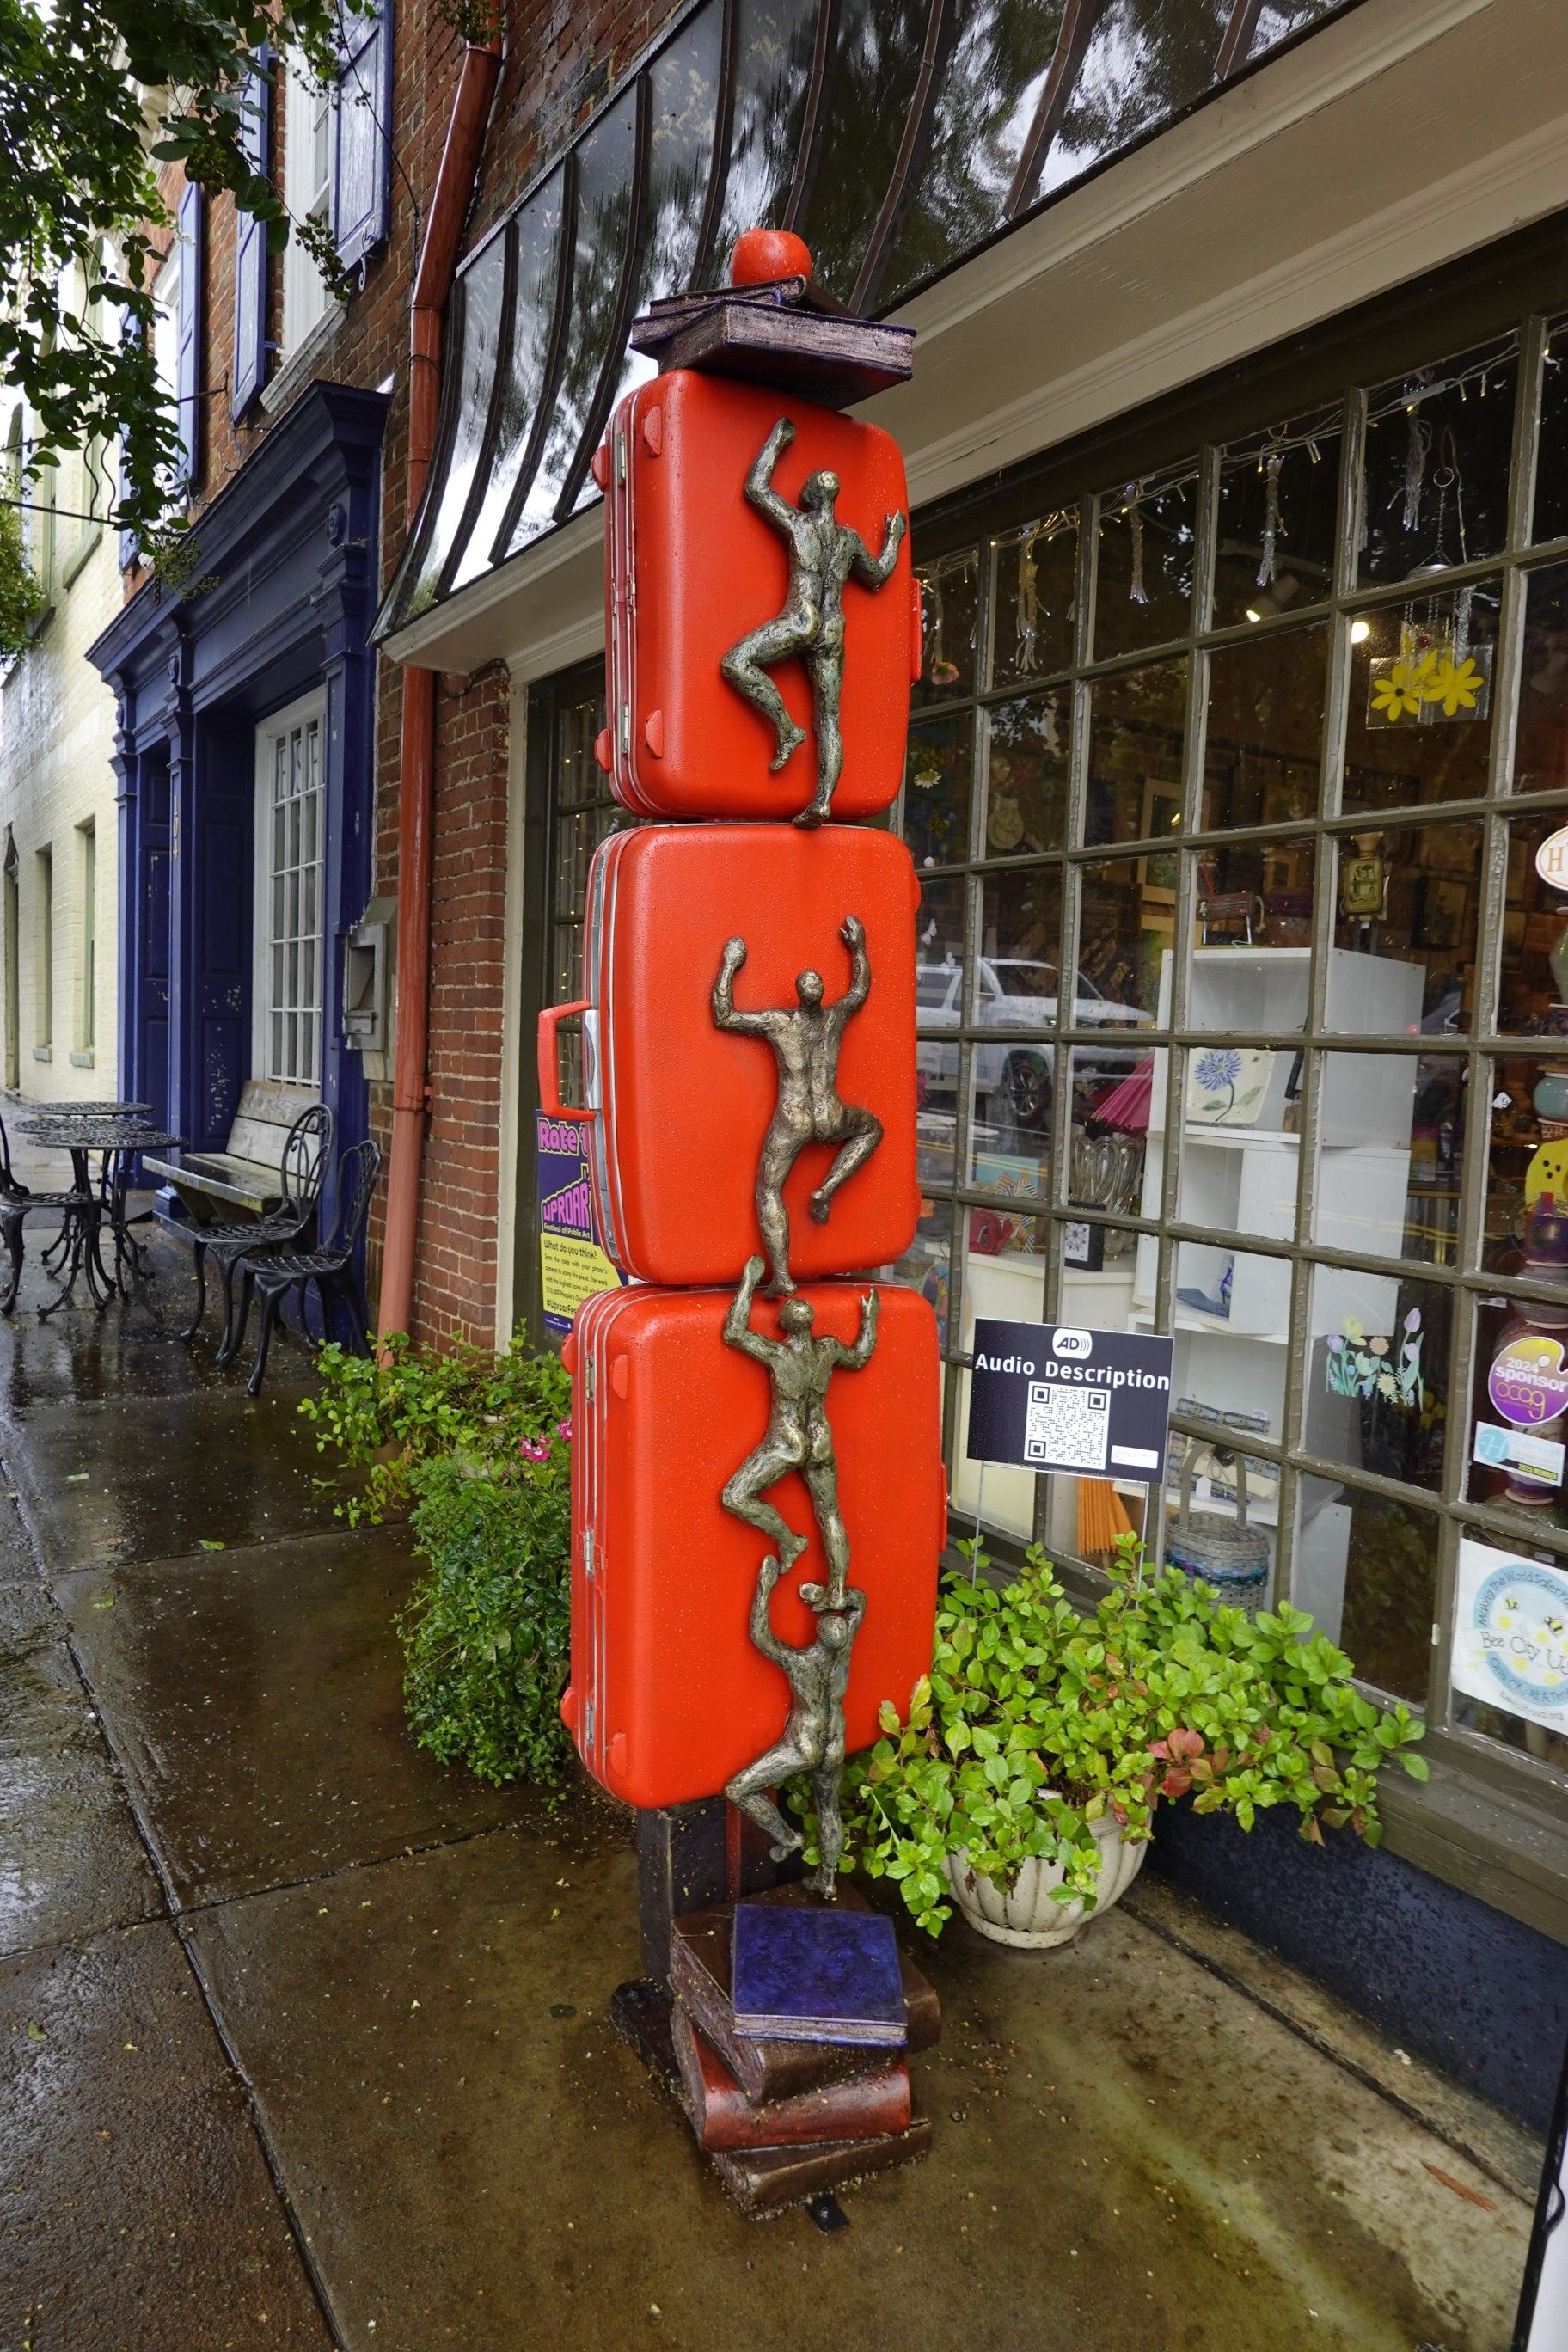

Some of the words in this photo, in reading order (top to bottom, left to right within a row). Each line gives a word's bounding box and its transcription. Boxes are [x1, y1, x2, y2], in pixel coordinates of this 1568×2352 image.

[538, 1119, 578, 1153] Rate
[544, 1222, 561, 1233] Festival
[567, 1227, 582, 1237] Public
[582, 1230, 591, 1239] Art
[544, 1240, 559, 1251] What
[560, 1242, 567, 1253] do
[567, 1246, 579, 1256] you
[579, 1246, 597, 1259] think?
[975, 1353, 1036, 1375] Audio
[1045, 1361, 1170, 1391] Description
[1506, 1357, 1540, 1374] 2024
[1494, 1366, 1568, 1393] sponsor
[1478, 1590, 1495, 1626] Making
[1489, 1577, 1506, 1591] The
[1505, 1569, 1534, 1583] World
[1534, 1573, 1561, 1594] Safer
[1480, 1631, 1506, 1650] Bee
[1510, 1635, 1540, 1661] City
[1491, 1657, 1507, 1681] One
